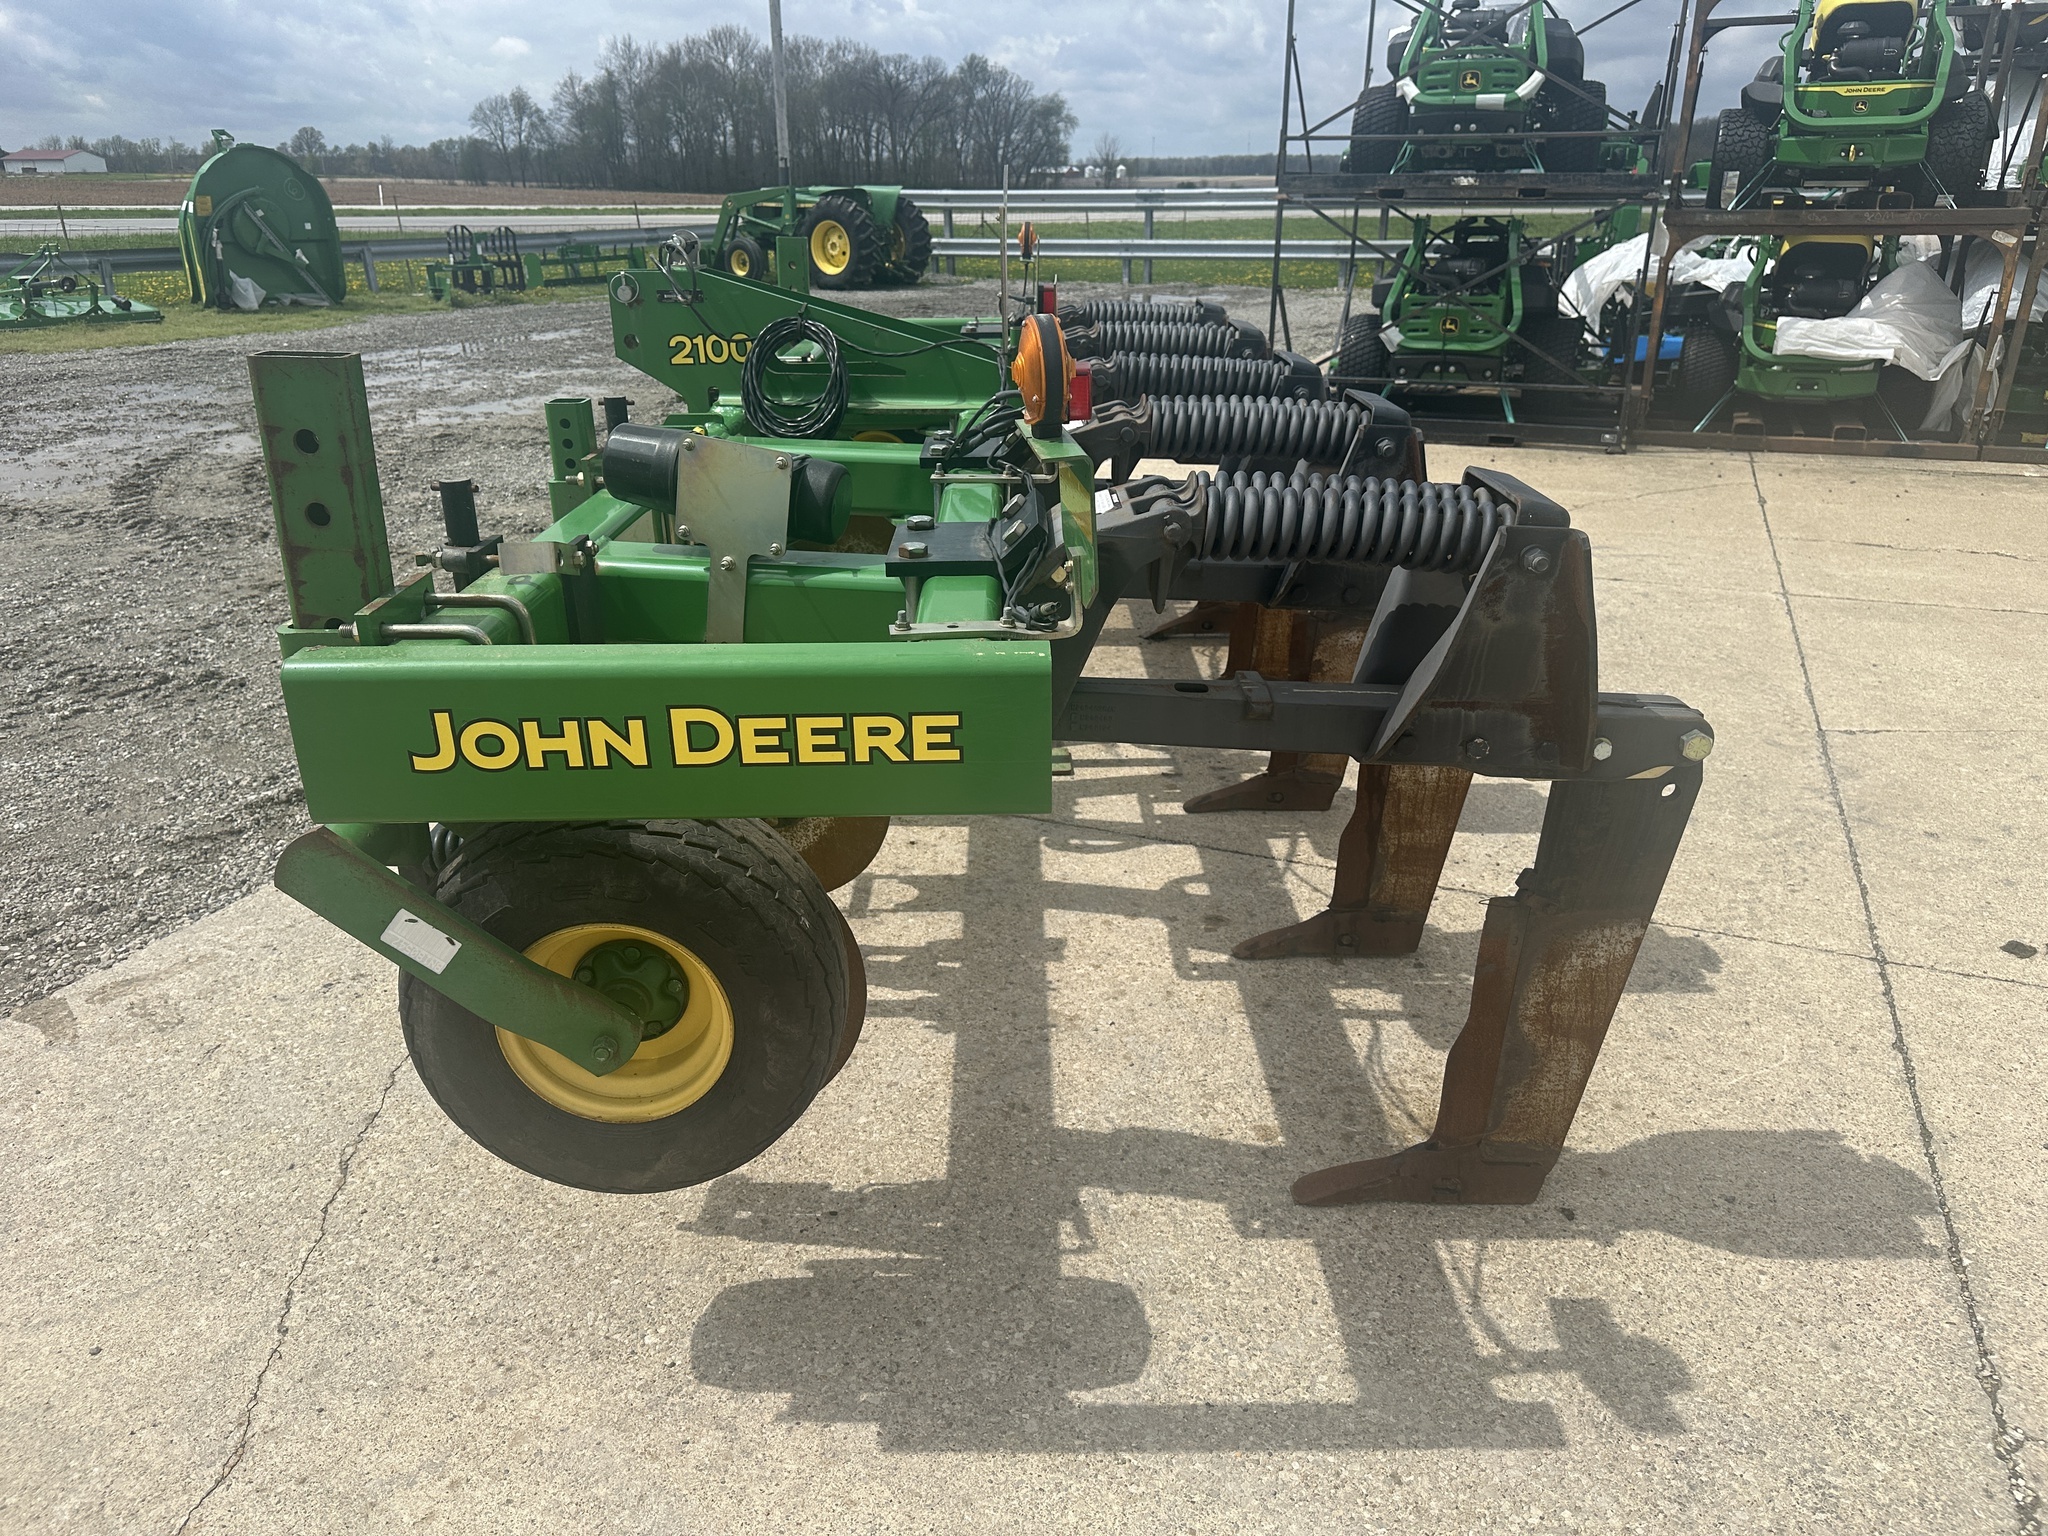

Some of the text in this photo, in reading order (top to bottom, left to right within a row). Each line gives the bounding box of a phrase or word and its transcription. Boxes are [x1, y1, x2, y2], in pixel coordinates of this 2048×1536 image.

[668, 332, 756, 366] 2100
[409, 705, 963, 774] JOHN DEERE
